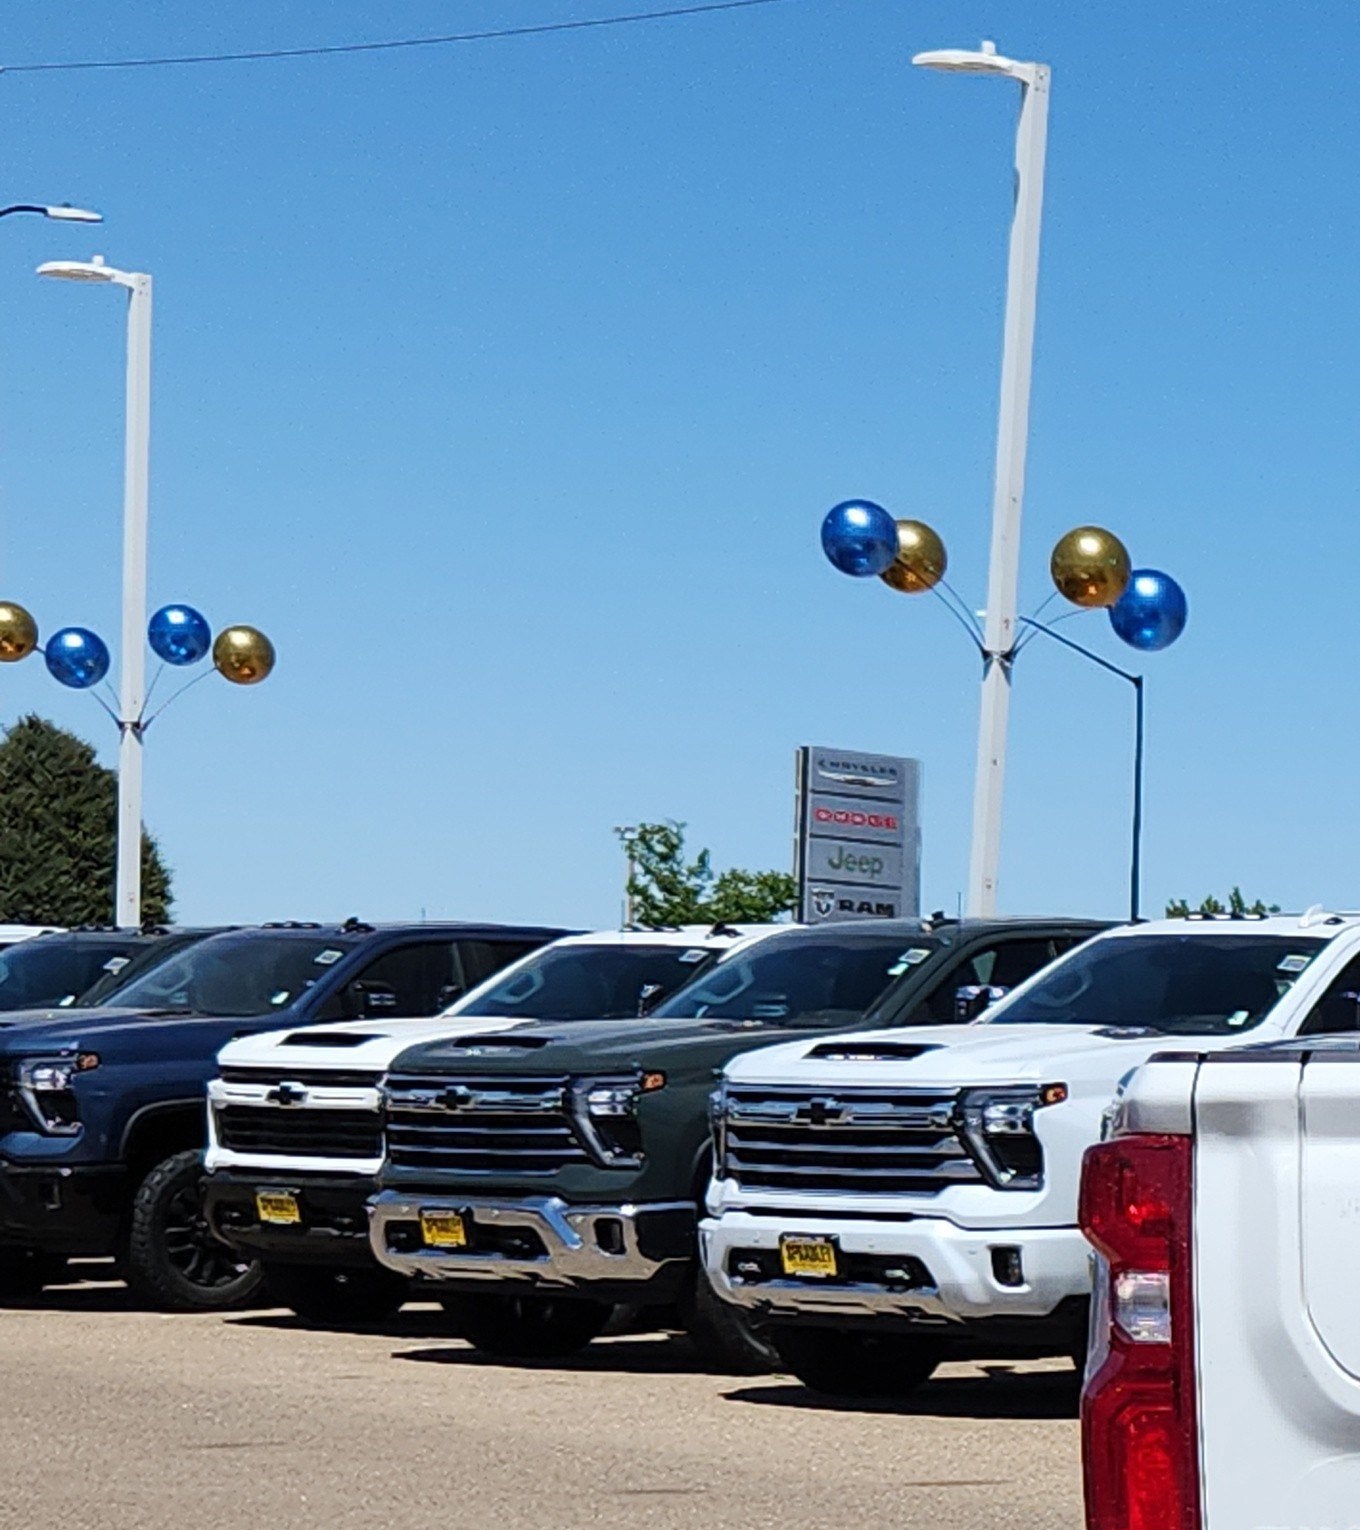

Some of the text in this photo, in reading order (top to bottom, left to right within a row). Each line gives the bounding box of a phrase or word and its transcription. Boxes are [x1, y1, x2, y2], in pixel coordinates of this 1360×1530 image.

[817, 760, 899, 776] CHRYSLER
[815, 808, 898, 829] DODGE
[828, 846, 884, 878] Jeep
[839, 899, 894, 918] RAM
